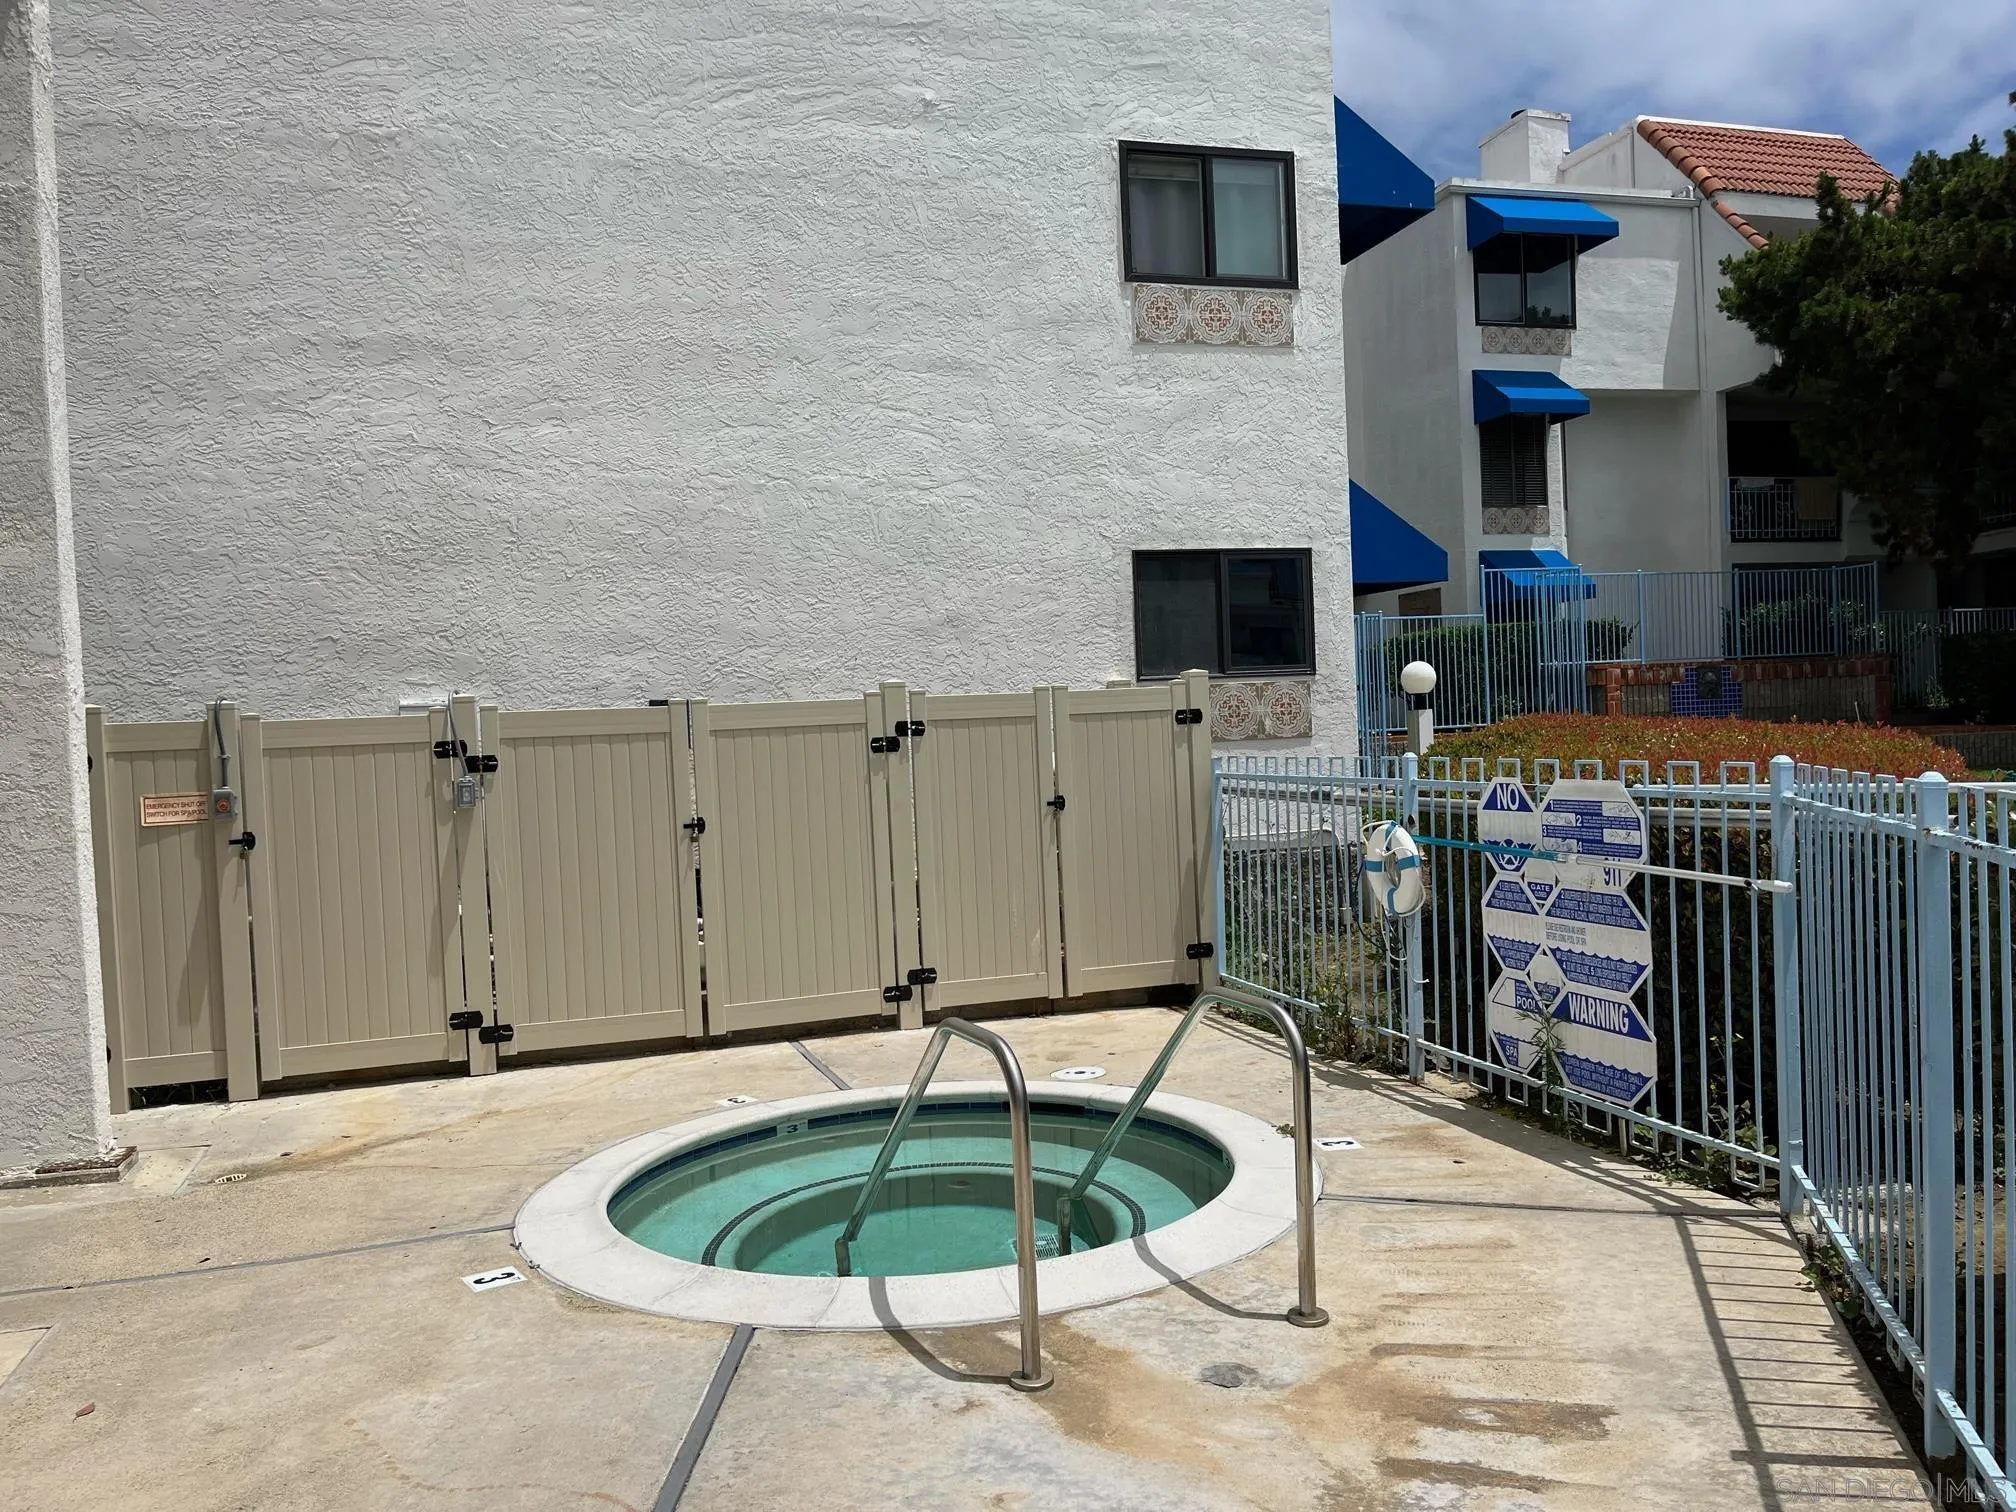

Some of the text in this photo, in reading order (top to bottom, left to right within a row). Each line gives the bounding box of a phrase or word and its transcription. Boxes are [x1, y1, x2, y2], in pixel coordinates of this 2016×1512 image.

[1496, 783, 1519, 810] NO
[146, 802, 180, 810] EMERGENCY
[1576, 815, 1582, 826] 2
[1542, 826, 1547, 836] 3
[1530, 883, 1551, 892] GATE
[1516, 996, 1538, 1013] POOL
[1568, 992, 1629, 1034] WARNING
[1505, 1045, 1518, 1058] SPA
[787, 1124, 798, 1133] 3
[473, 1272, 516, 1285] 3
